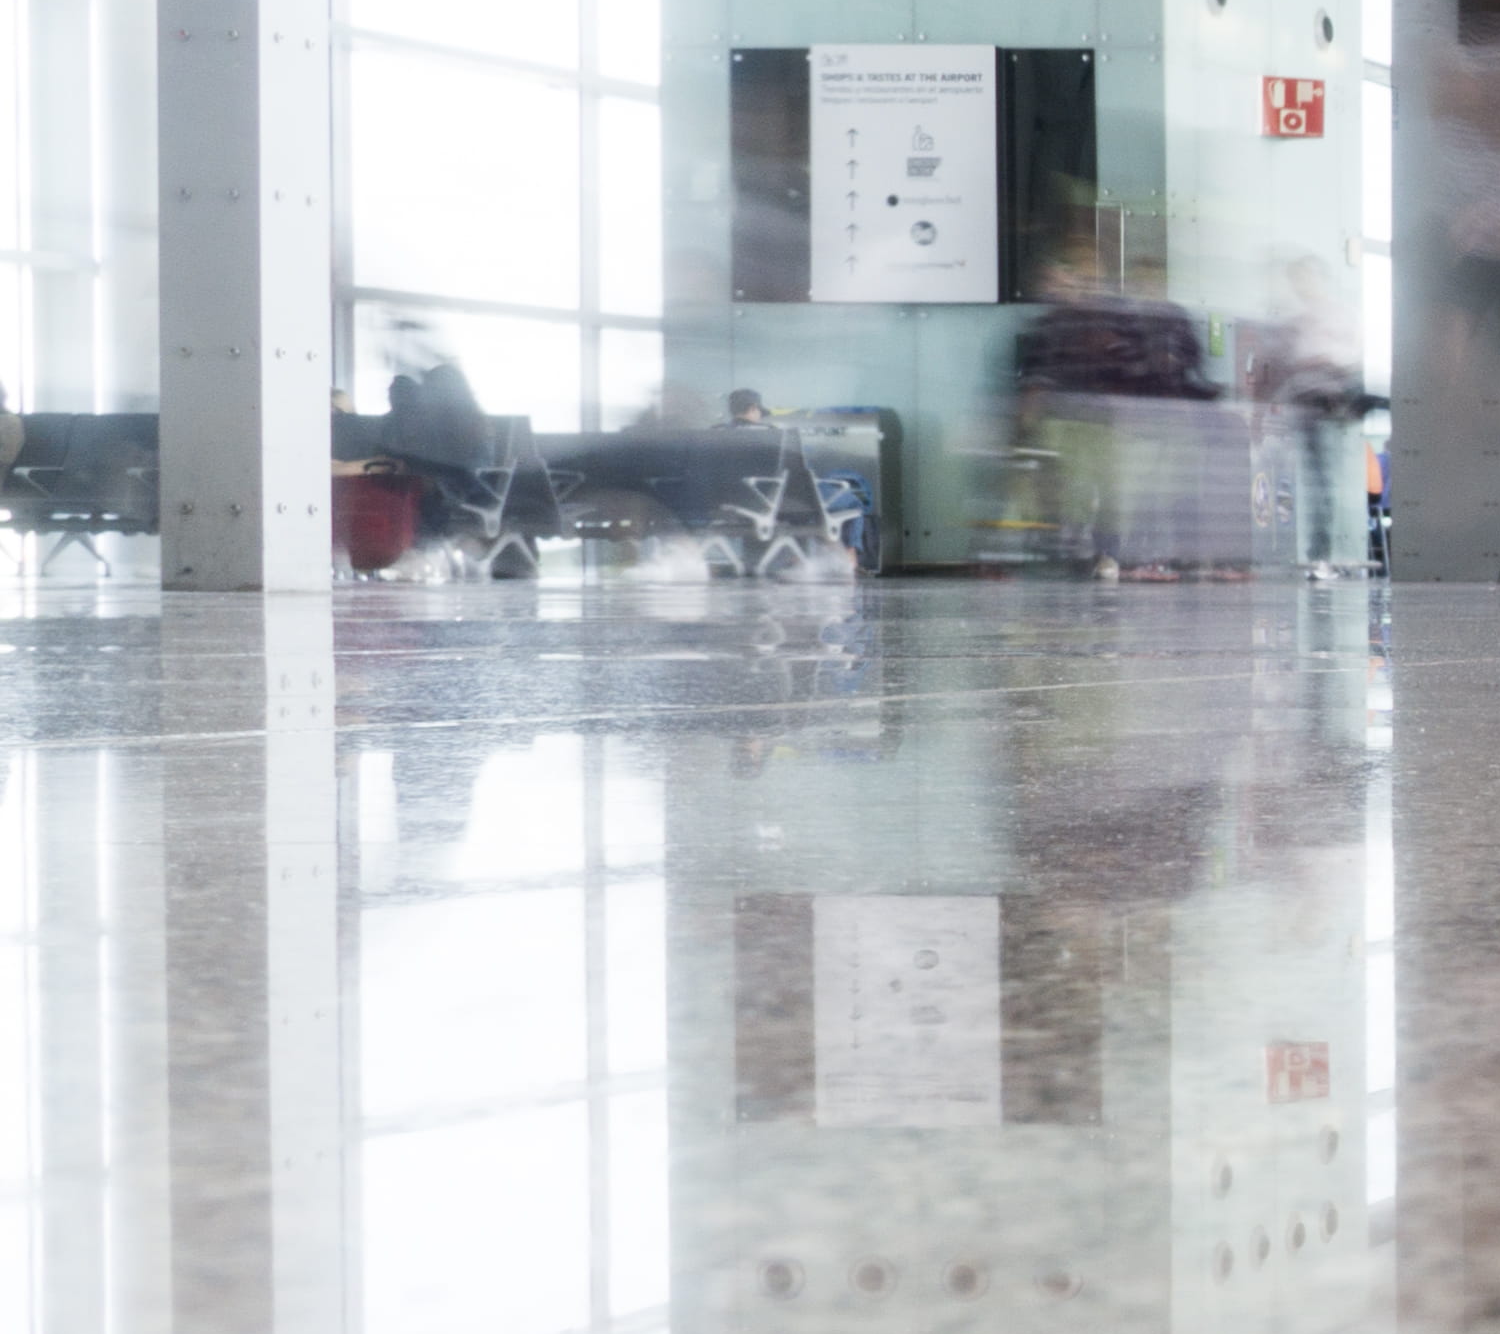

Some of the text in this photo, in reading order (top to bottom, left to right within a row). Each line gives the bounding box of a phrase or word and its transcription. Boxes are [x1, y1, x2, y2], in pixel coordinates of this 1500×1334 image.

[904, 73, 917, 82] AT
[920, 73, 937, 82] THE
[941, 73, 983, 82] AIRPORT
